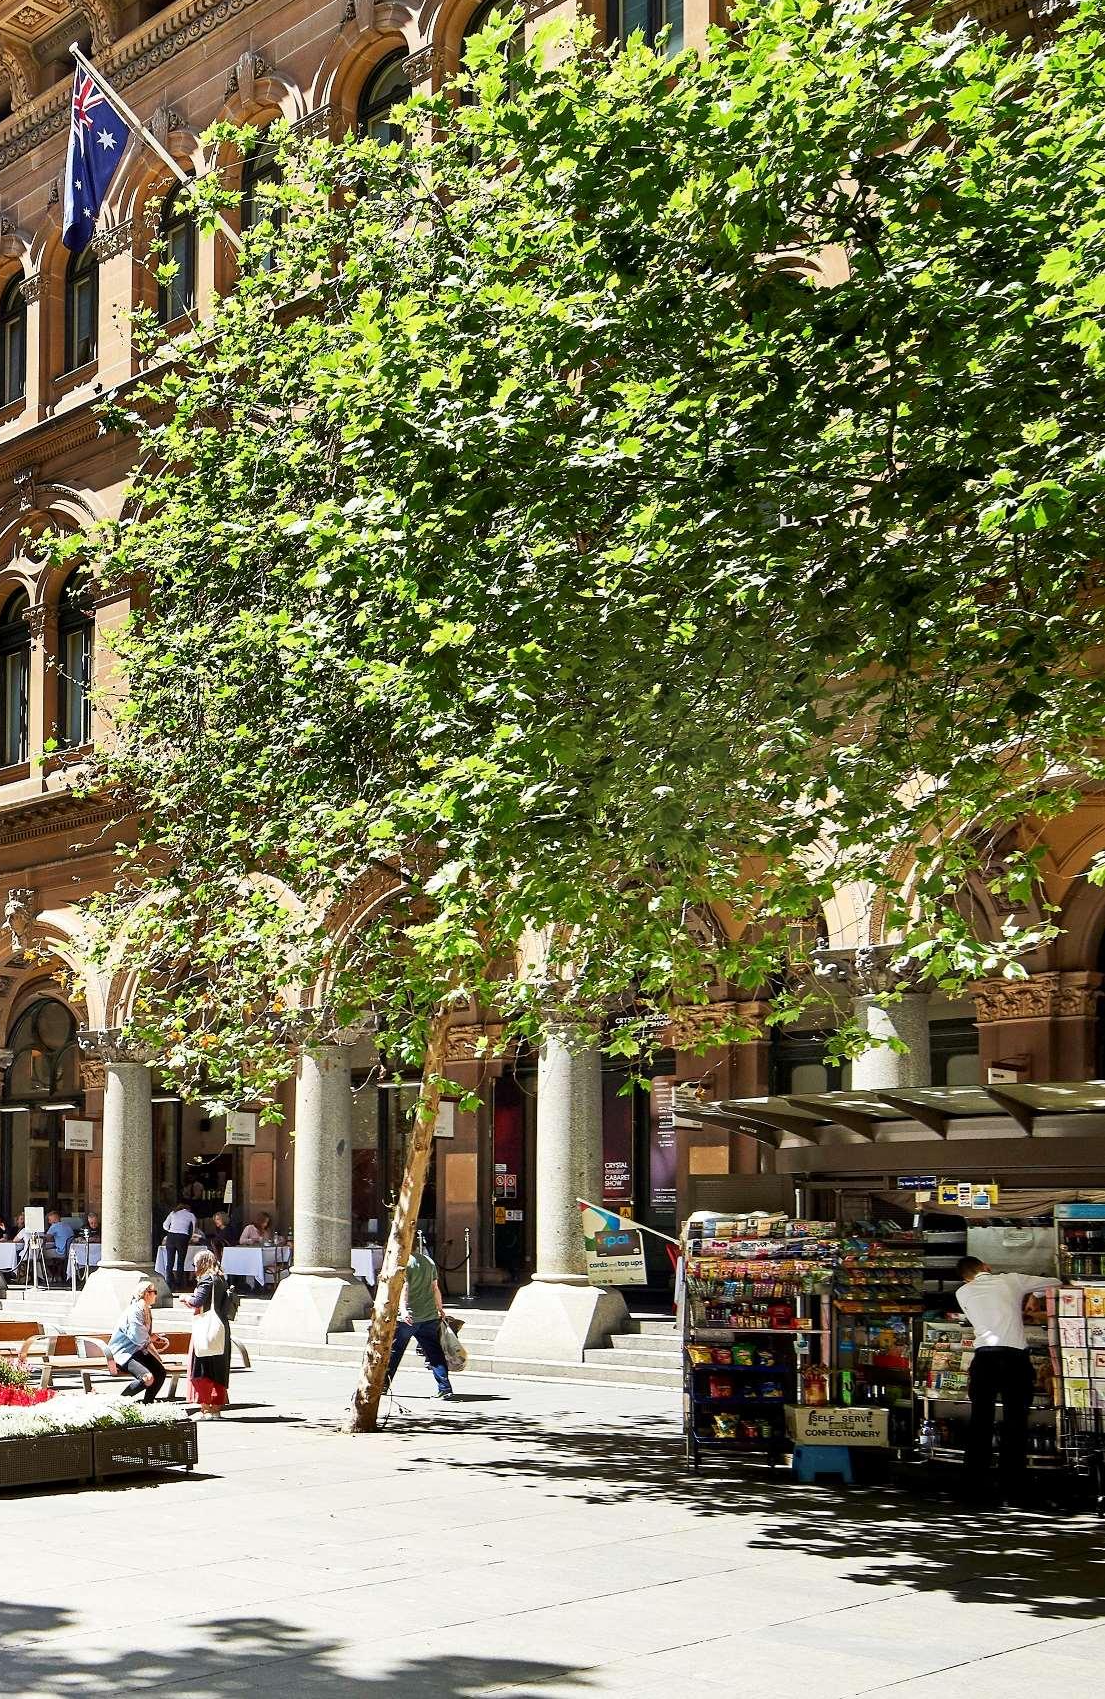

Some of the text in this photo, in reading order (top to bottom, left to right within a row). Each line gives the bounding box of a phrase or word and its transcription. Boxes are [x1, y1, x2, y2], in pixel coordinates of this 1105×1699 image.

[630, 1259, 643, 1267] ups
[811, 1414, 873, 1423] SELF SERVE
[805, 1429, 881, 1438] CONFECTIONERY
